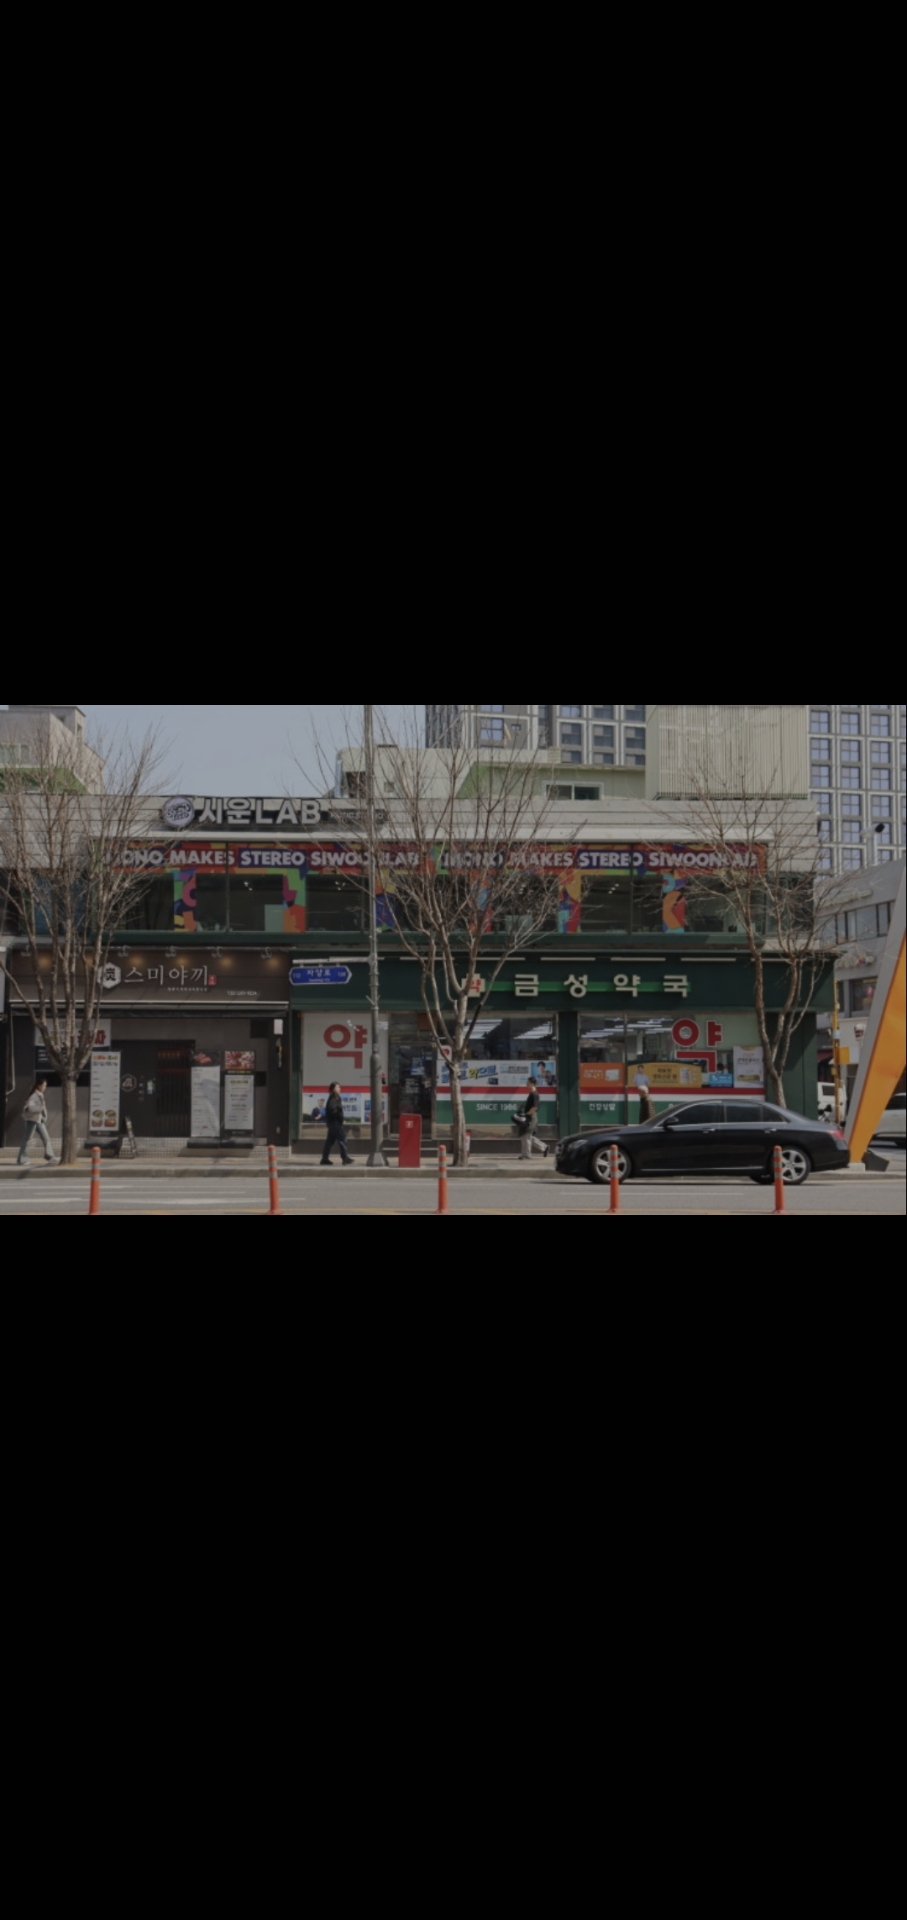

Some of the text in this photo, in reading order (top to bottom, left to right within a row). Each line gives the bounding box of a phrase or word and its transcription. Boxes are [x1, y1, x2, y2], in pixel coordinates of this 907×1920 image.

[199, 798, 321, 825] 시운LAB
[169, 849, 235, 866] MAKES
[240, 851, 305, 866] STEREO
[310, 851, 420, 866] SIWOOLAB
[509, 851, 573, 867] MAKES
[579, 852, 643, 867] STEREO
[648, 852, 758, 867] SIWOONAB
[124, 965, 207, 986] 스미야끼
[306, 968, 331, 978] 자양로
[514, 972, 690, 999] 금성약국
[323, 1023, 367, 1070] 약
[671, 1018, 723, 1073] 약
[475, 1103, 499, 1112] SINCE
